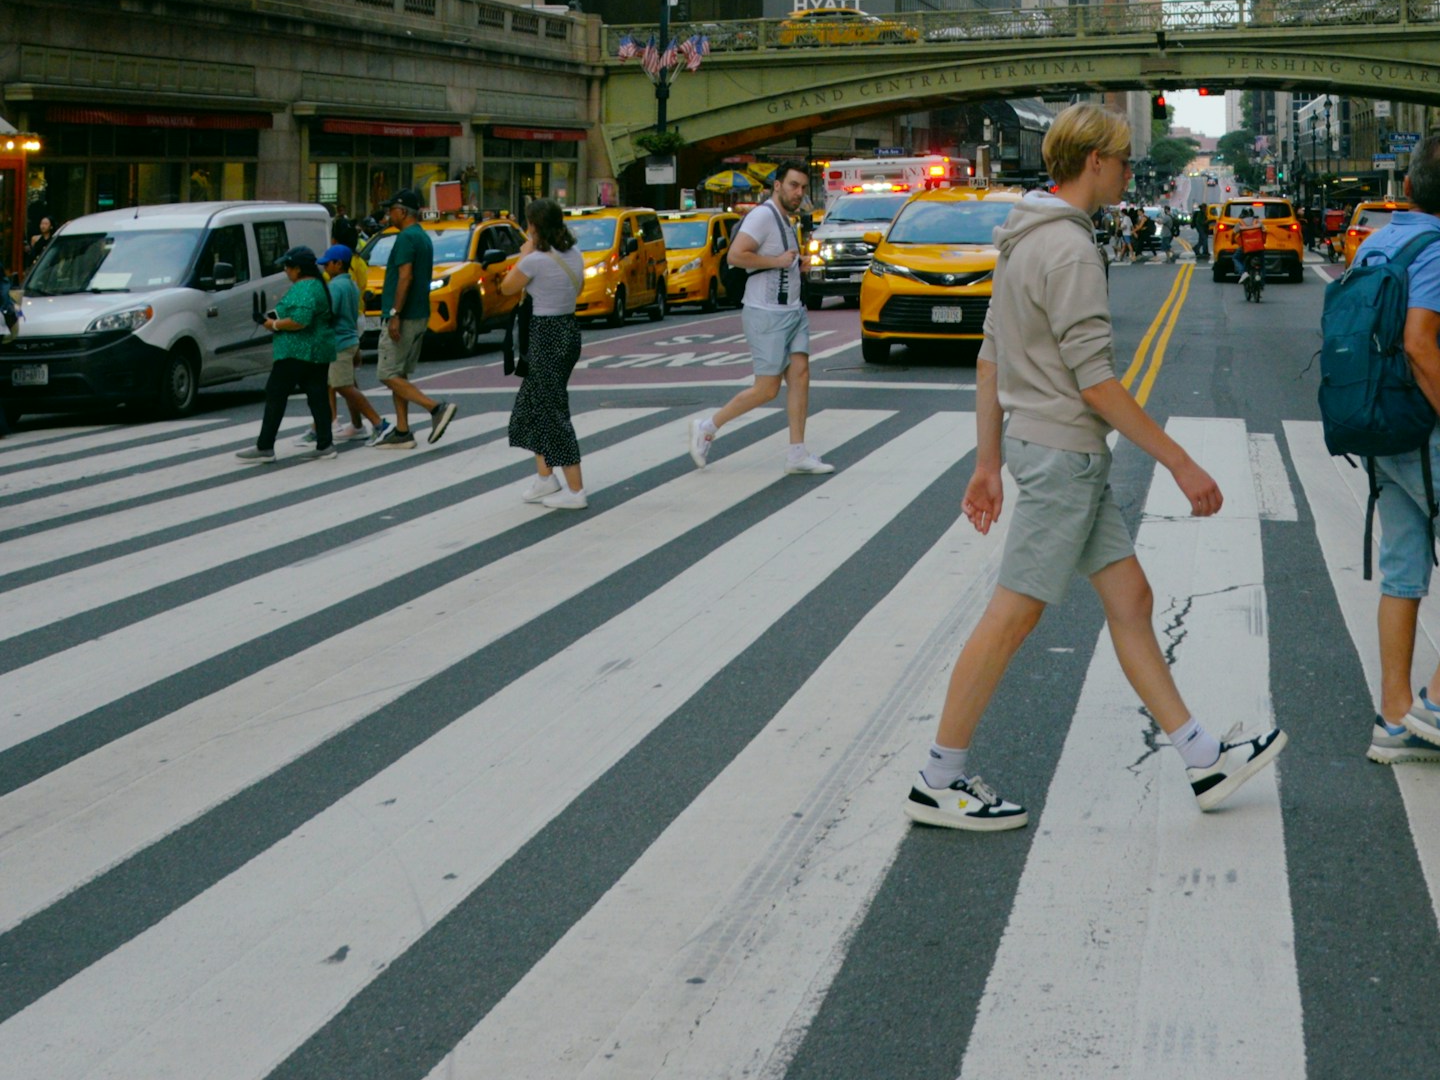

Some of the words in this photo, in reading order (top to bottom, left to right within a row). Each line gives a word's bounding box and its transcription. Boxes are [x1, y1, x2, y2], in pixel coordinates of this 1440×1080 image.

[1227, 57, 1342, 74] PERSHING
[767, 89, 844, 115] GRAND
[860, 70, 962, 98] CENTRAL
[980, 61, 1095, 81] TERMINAL
